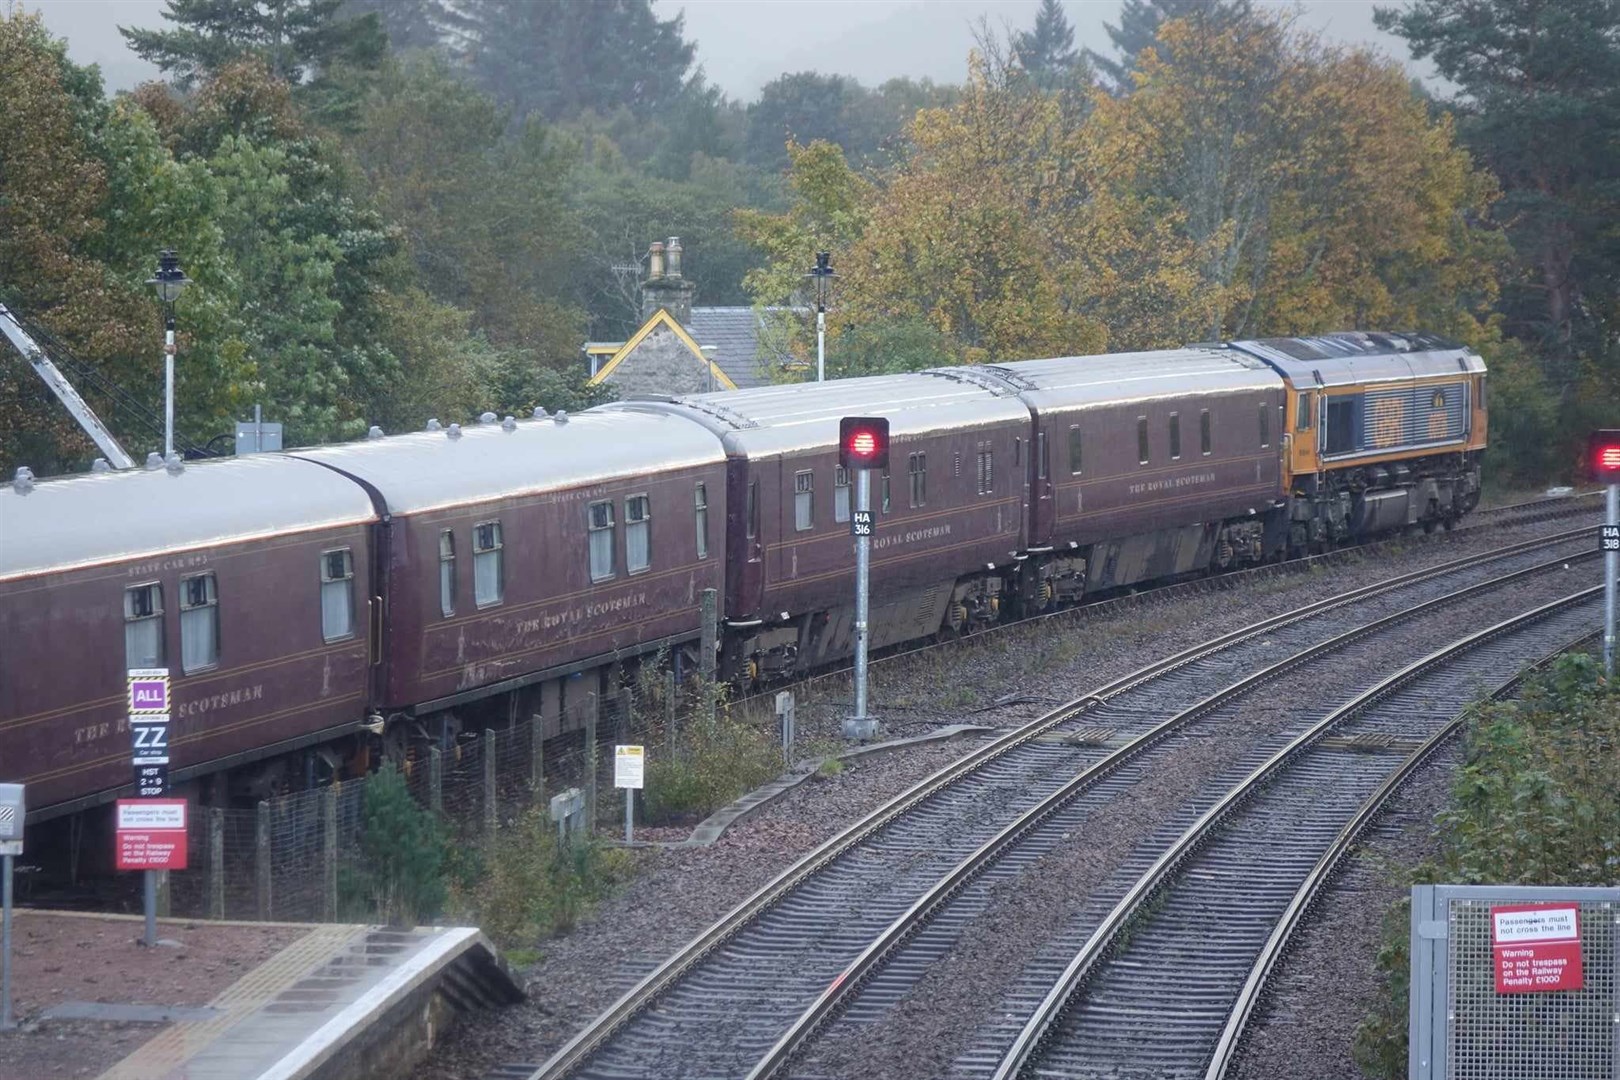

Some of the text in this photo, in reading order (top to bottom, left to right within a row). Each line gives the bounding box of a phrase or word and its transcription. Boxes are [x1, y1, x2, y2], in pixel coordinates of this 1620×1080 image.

[854, 512, 871, 523] HA
[854, 524, 871, 535] 316
[1602, 527, 1620, 537] HA
[873, 534, 903, 550] ROYAL
[905, 524, 952, 543] SCOTSMAN
[1602, 538, 1620, 549] 318
[515, 592, 647, 634] THE ROYAL SCOTSMAN
[135, 689, 163, 702] ALL
[74, 720, 111, 744] THE
[178, 684, 264, 719] SCOTSMAN
[133, 727, 167, 748] ZZ
[142, 767, 159, 776] HST
[140, 778, 147, 786] 2
[155, 777, 162, 786] 9
[140, 787, 163, 796] STOP
[1500, 915, 1569, 926] Passengers must
[1500, 927, 1513, 935] not
[1501, 949, 1534, 958] Warning
[1502, 958, 1568, 969] Do not trespass
[1516, 968, 1529, 976] the
[1532, 967, 1563, 976] Railway
[1503, 975, 1560, 987] Penalty £1000
